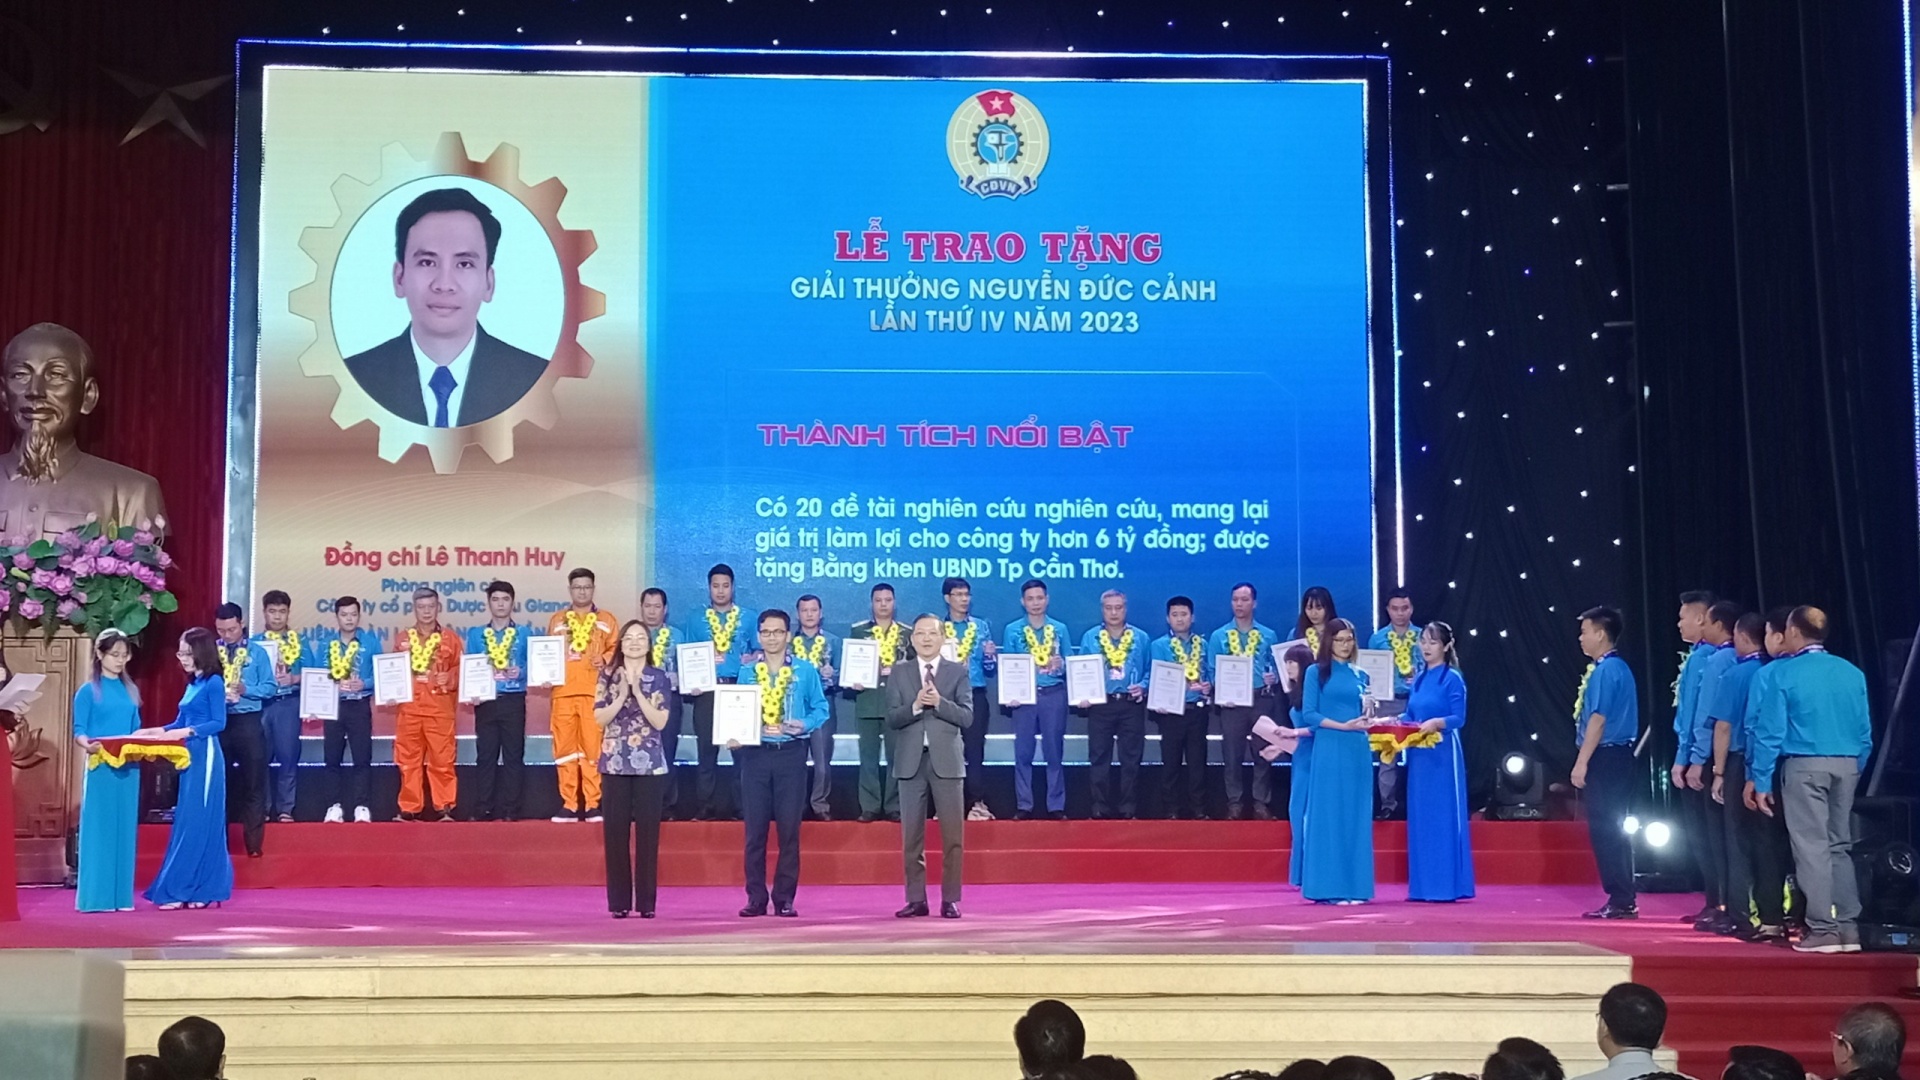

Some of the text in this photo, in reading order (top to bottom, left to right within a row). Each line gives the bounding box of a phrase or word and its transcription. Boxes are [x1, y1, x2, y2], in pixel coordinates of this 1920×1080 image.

[834, 217, 1162, 271] LỄ TRAO TẶNG
[791, 269, 1217, 301] GIẢI THƯỞNG NGUYỄN ĐỨC CẢNH
[869, 299, 1140, 333] LẦN THỨ IV NĂM 2023
[757, 414, 1133, 453] THÀNH TÍCH NỔI BẬT
[755, 492, 1269, 525] Có 20 đề tài nghiên cứu nghiên cứu, mang lại
[755, 522, 1270, 555] giá trị làm lợi cho công ty hơn 6 tỷ đồng; được
[324, 540, 565, 572] Đồng chí Lê Thanh Huy
[754, 552, 1125, 583] tặng Bằng khen UBND Tp Cần Thơ.
[362, 599, 376, 616] ty
[380, 594, 400, 613] cổ
[447, 598, 486, 616] Dược
